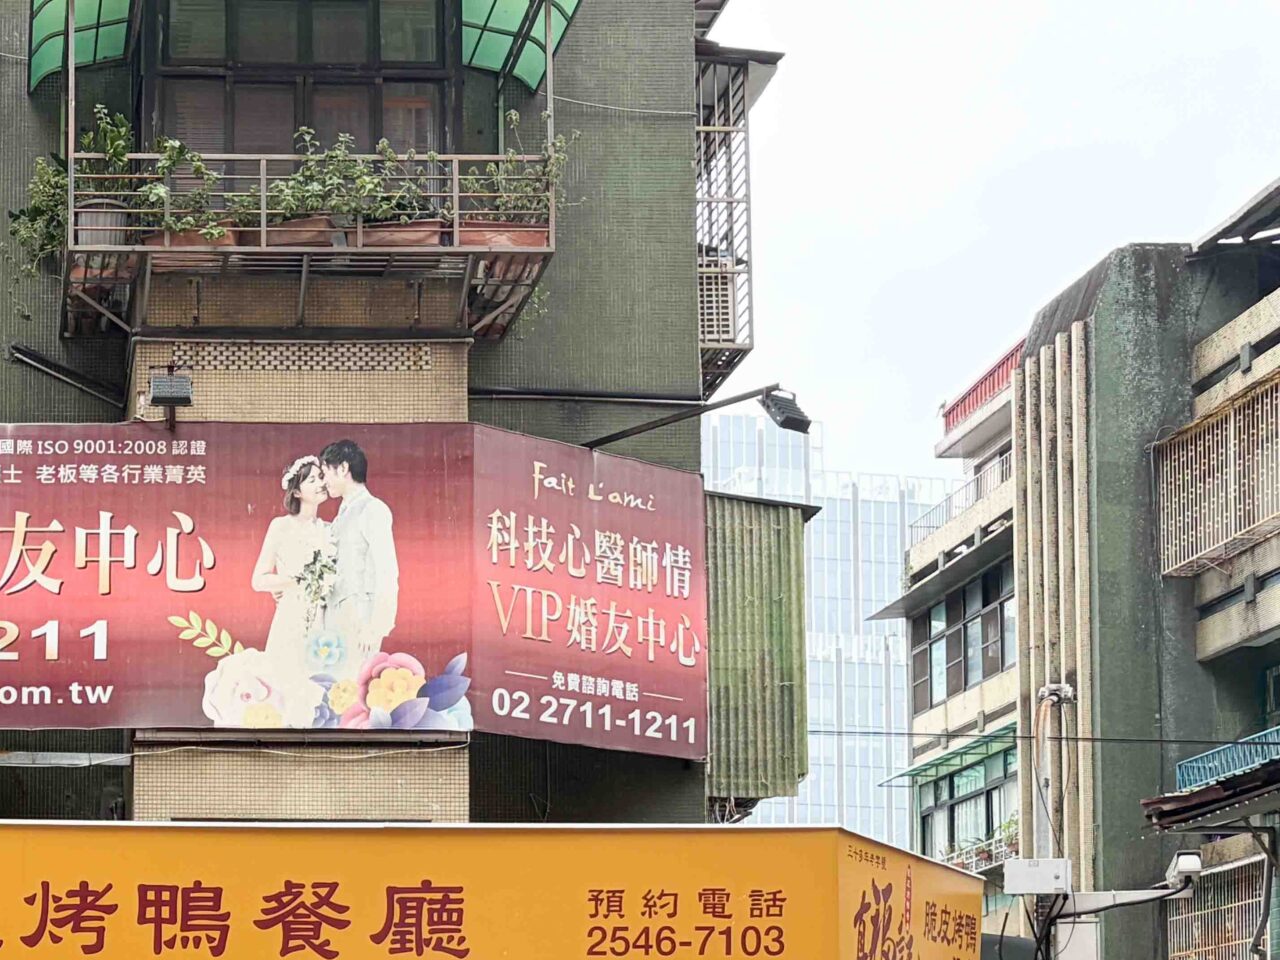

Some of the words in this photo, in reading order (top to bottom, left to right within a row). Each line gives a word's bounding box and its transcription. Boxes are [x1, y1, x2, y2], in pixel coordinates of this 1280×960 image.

[37, 440, 68, 455] ISO
[73, 440, 167, 455] 9001:2008
[171, 440, 207, 455] 認證
[36, 464, 207, 485] 老板等各行業菁英
[532, 460, 575, 499] Fait
[487, 508, 693, 599] 科技心醫師情
[487, 579, 701, 667] VIP婚友中心
[551, 671, 639, 702] 免費諮詢電話
[492, 688, 530, 719] 02
[539, 695, 696, 744] 2711-1211
[587, 888, 787, 920] 預約電話
[587, 926, 786, 957] 2546-7103
[923, 900, 977, 954] 脆皮烤鴨
